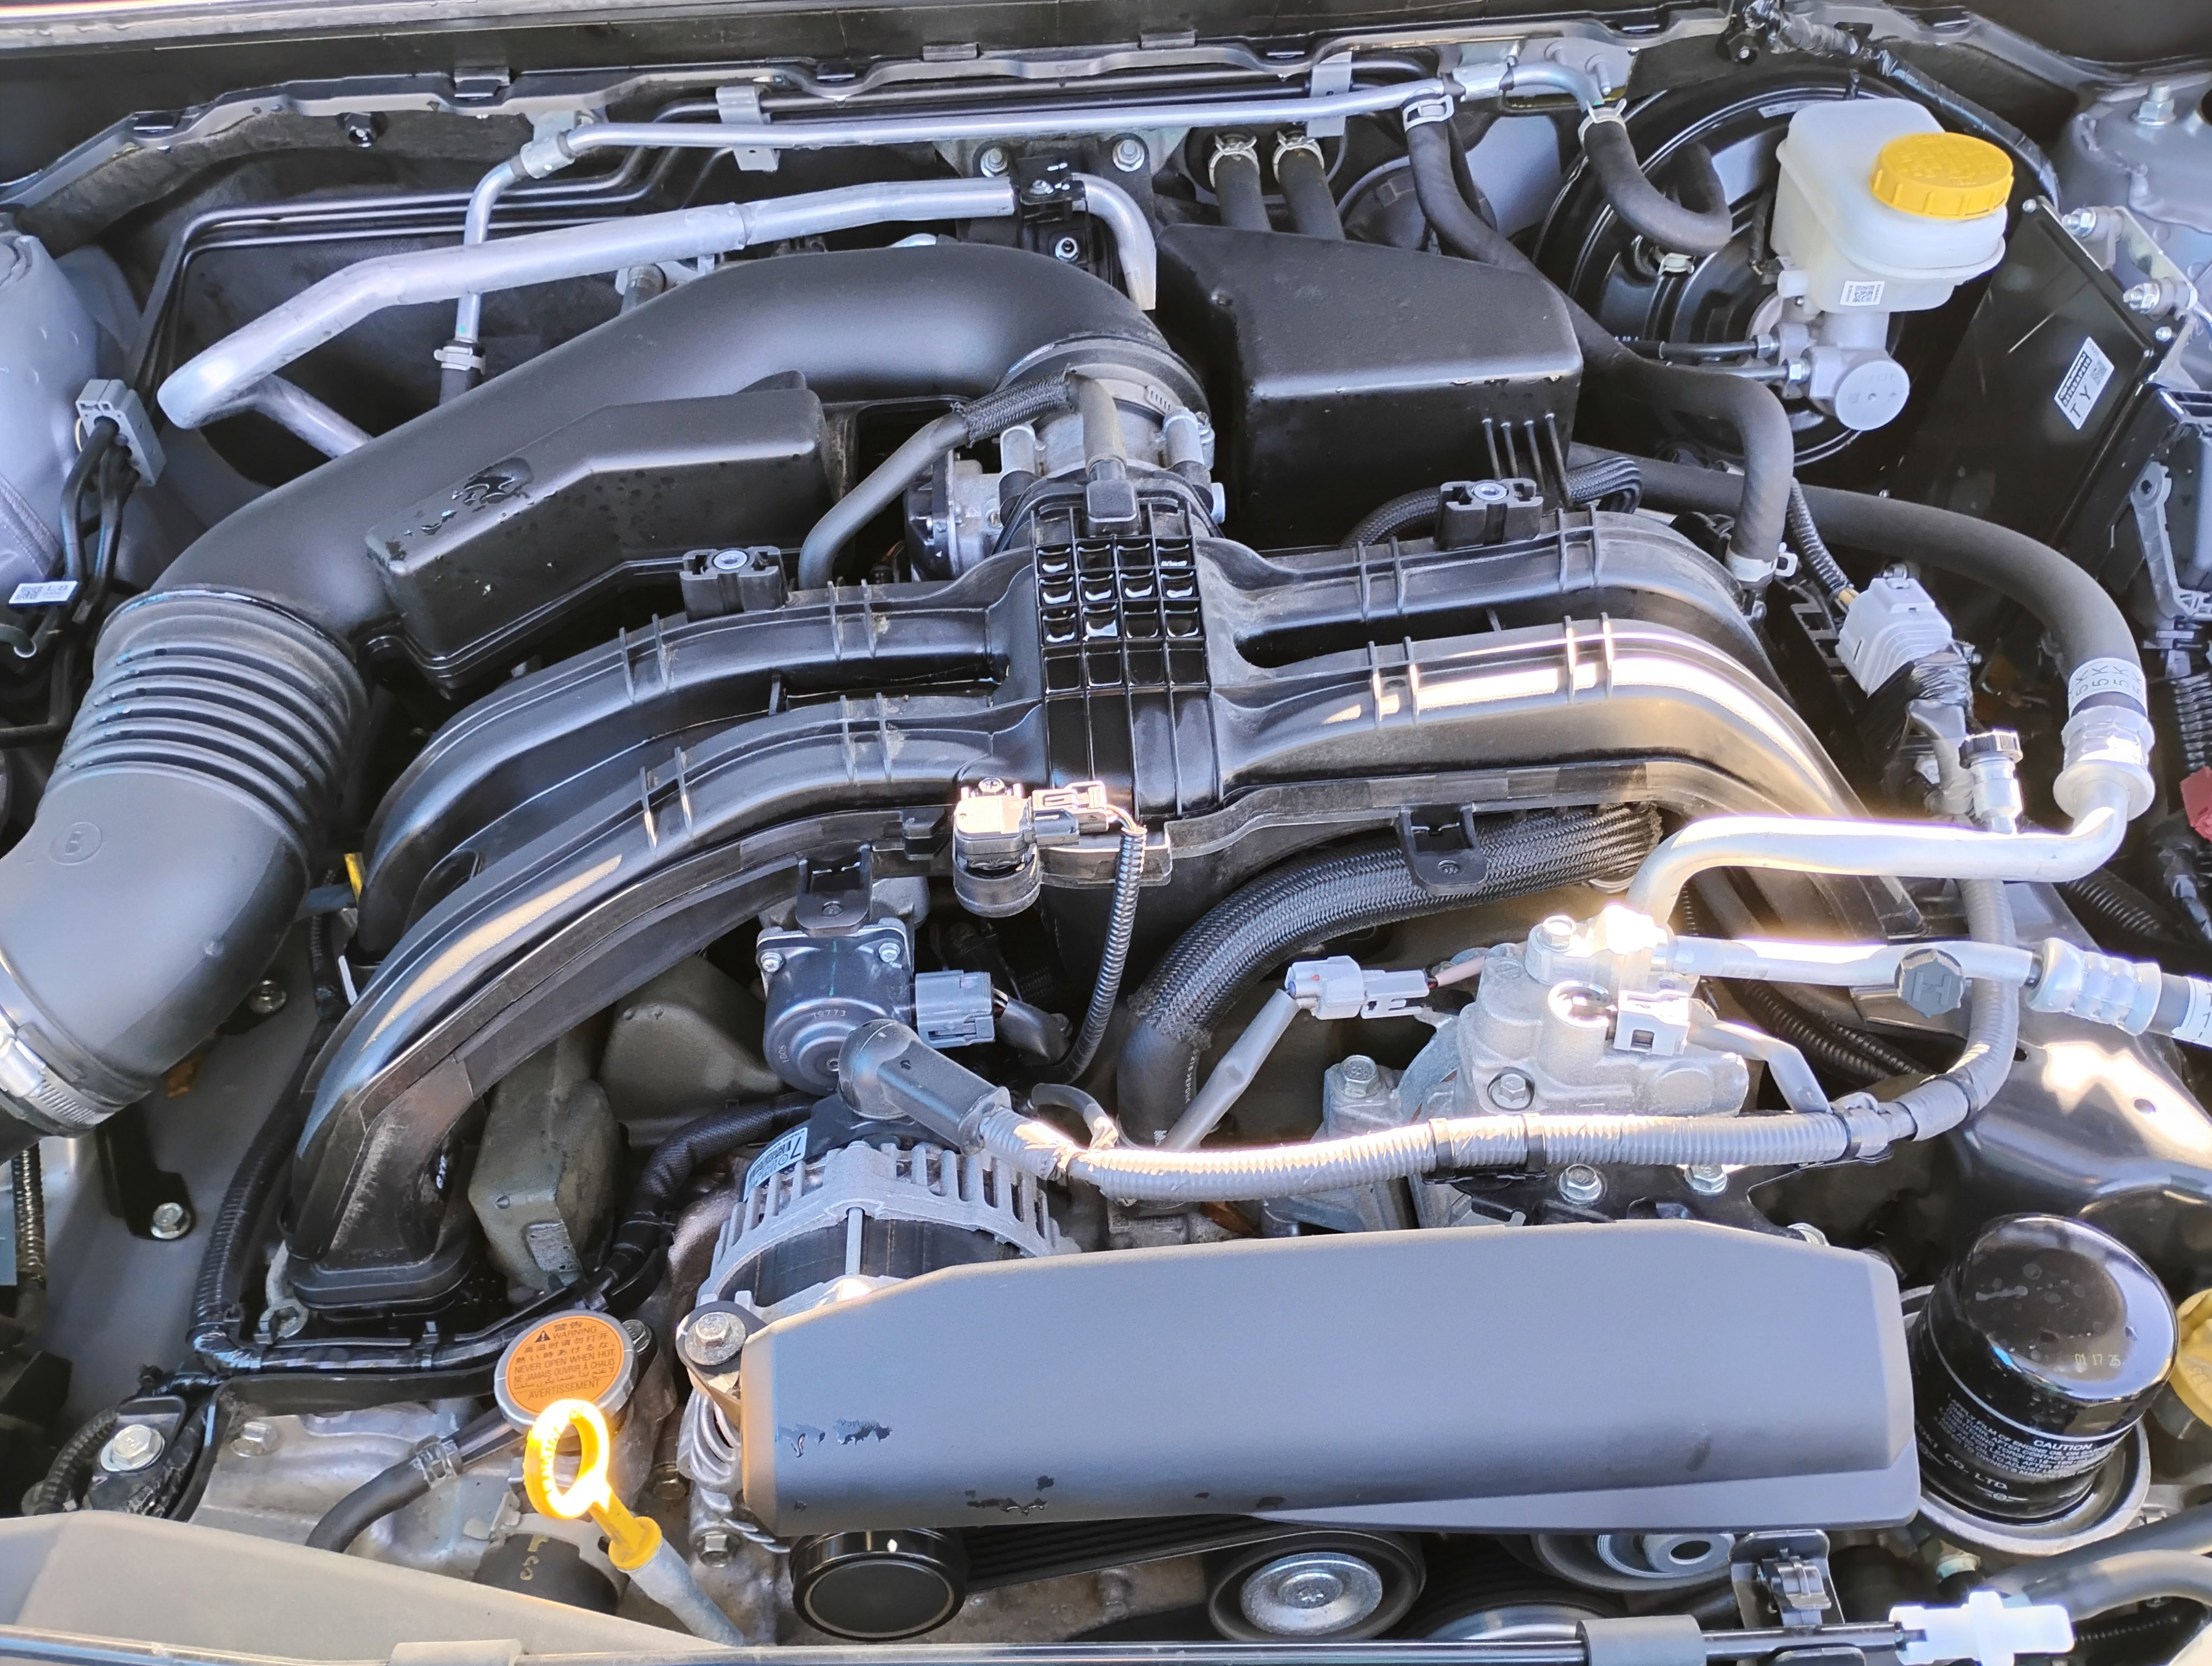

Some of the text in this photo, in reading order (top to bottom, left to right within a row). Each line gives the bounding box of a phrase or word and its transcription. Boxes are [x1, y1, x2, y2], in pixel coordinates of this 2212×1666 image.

[1911, 970, 1952, 1007] H
[552, 1325, 597, 1340] WARNING
[515, 1362, 541, 1374] NEVER
[544, 1357, 567, 1368] OPEN
[570, 1352, 595, 1363] WHEN
[528, 1378, 600, 1400] AVERTISSEMENT
[1976, 1419, 1998, 1436] FILM
[1997, 1433, 2012, 1443] OF
[2012, 1440, 2048, 1453] ENGINE
[1991, 1437, 2021, 1452] AFTER
[2033, 1439, 2093, 1451] CAUTION
[1992, 1453, 2004, 1463] TO
